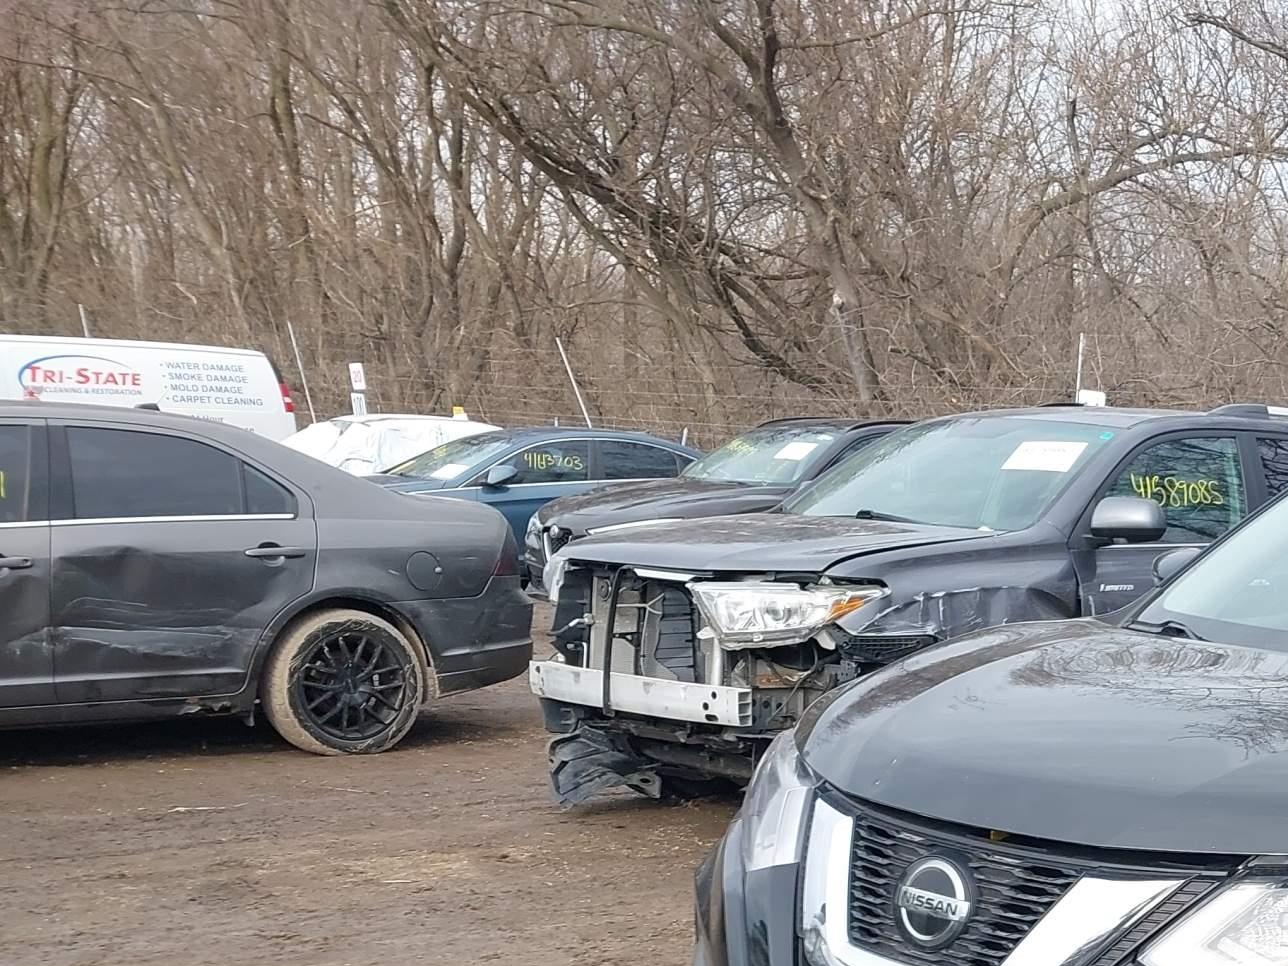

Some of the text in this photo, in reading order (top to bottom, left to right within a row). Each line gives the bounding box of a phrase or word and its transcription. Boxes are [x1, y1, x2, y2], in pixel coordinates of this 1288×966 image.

[165, 362, 246, 373] WATER DAMAGE
[168, 372, 249, 384] SMOKE DAMAGE
[91, 387, 143, 396] RESTORATION
[170, 383, 244, 394] MOLD DAMAGE
[172, 395, 264, 407] CARPET CLEANING
[1130, 472, 1224, 507] 41589085
[903, 890, 958, 916] NISSAN
